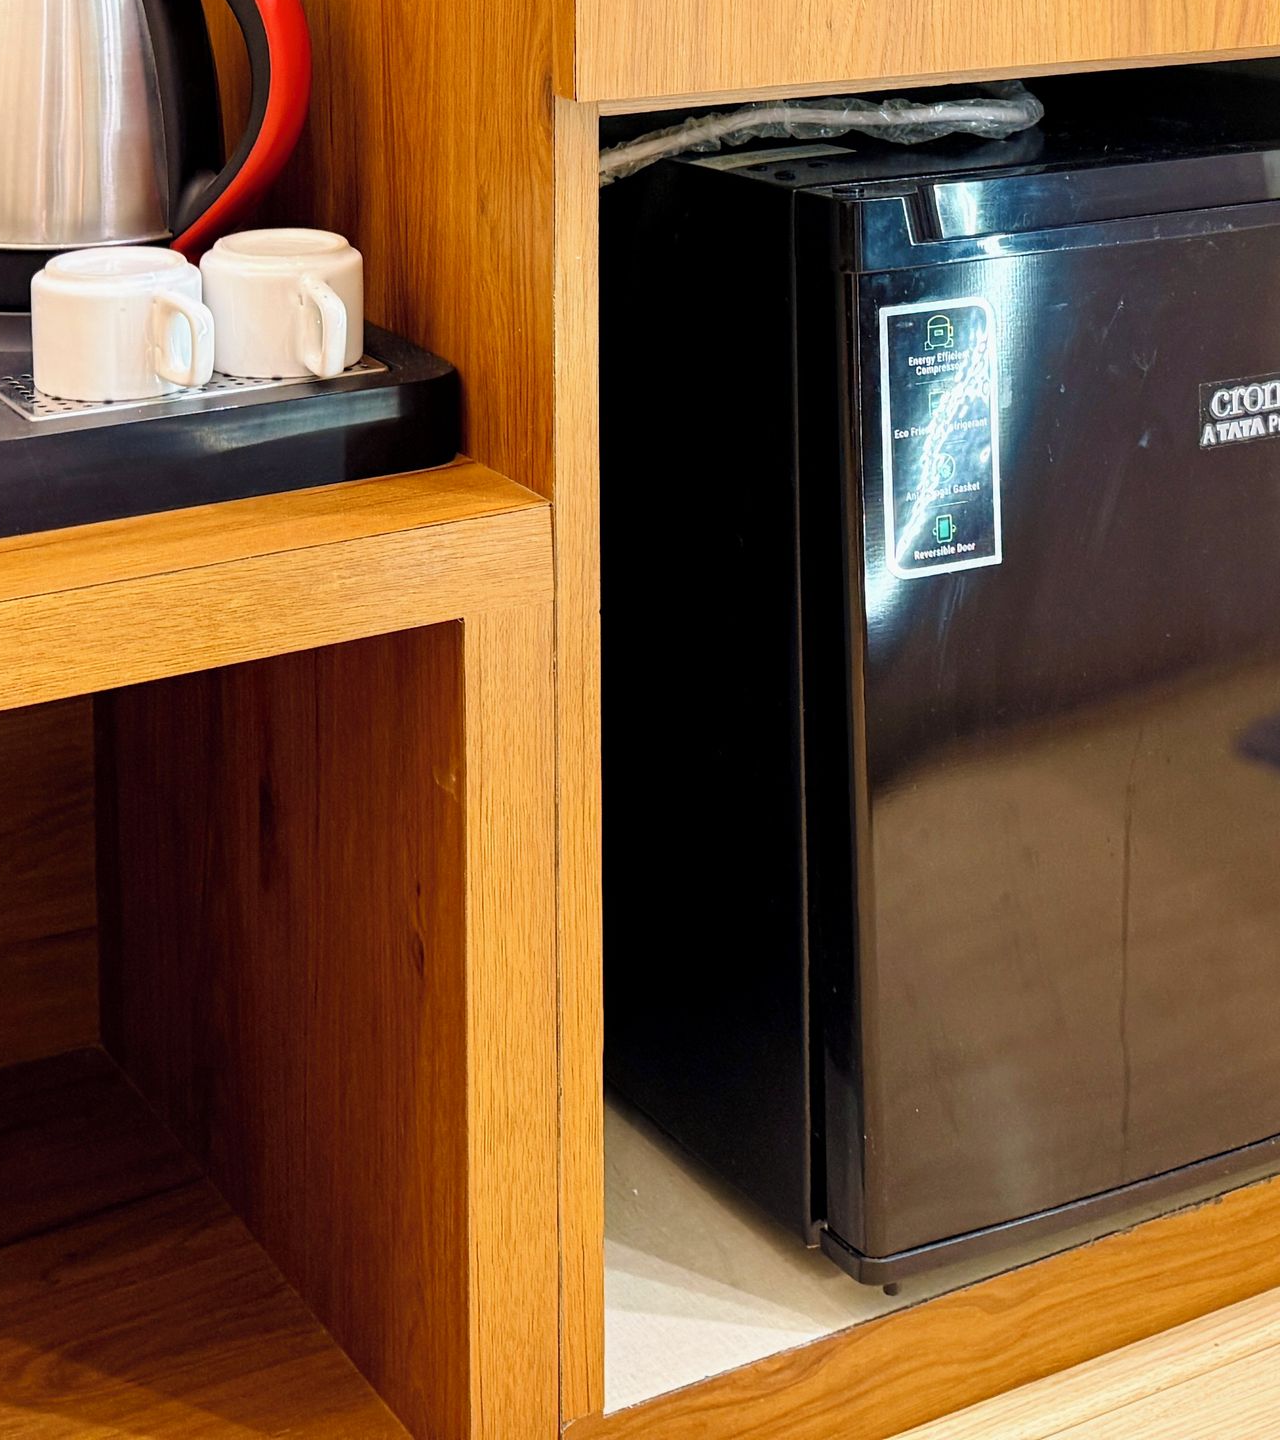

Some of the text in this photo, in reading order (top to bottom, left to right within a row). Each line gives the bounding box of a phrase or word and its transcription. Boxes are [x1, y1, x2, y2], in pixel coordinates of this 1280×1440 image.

[908, 355, 936, 367] Energy
[916, 362, 964, 376] Compresso
[894, 429, 909, 440] Eco
[1202, 425, 1216, 446] A
[1216, 417, 1266, 442] TATA
[953, 481, 980, 494] Gasket
[914, 542, 976, 561] Reversible Door
